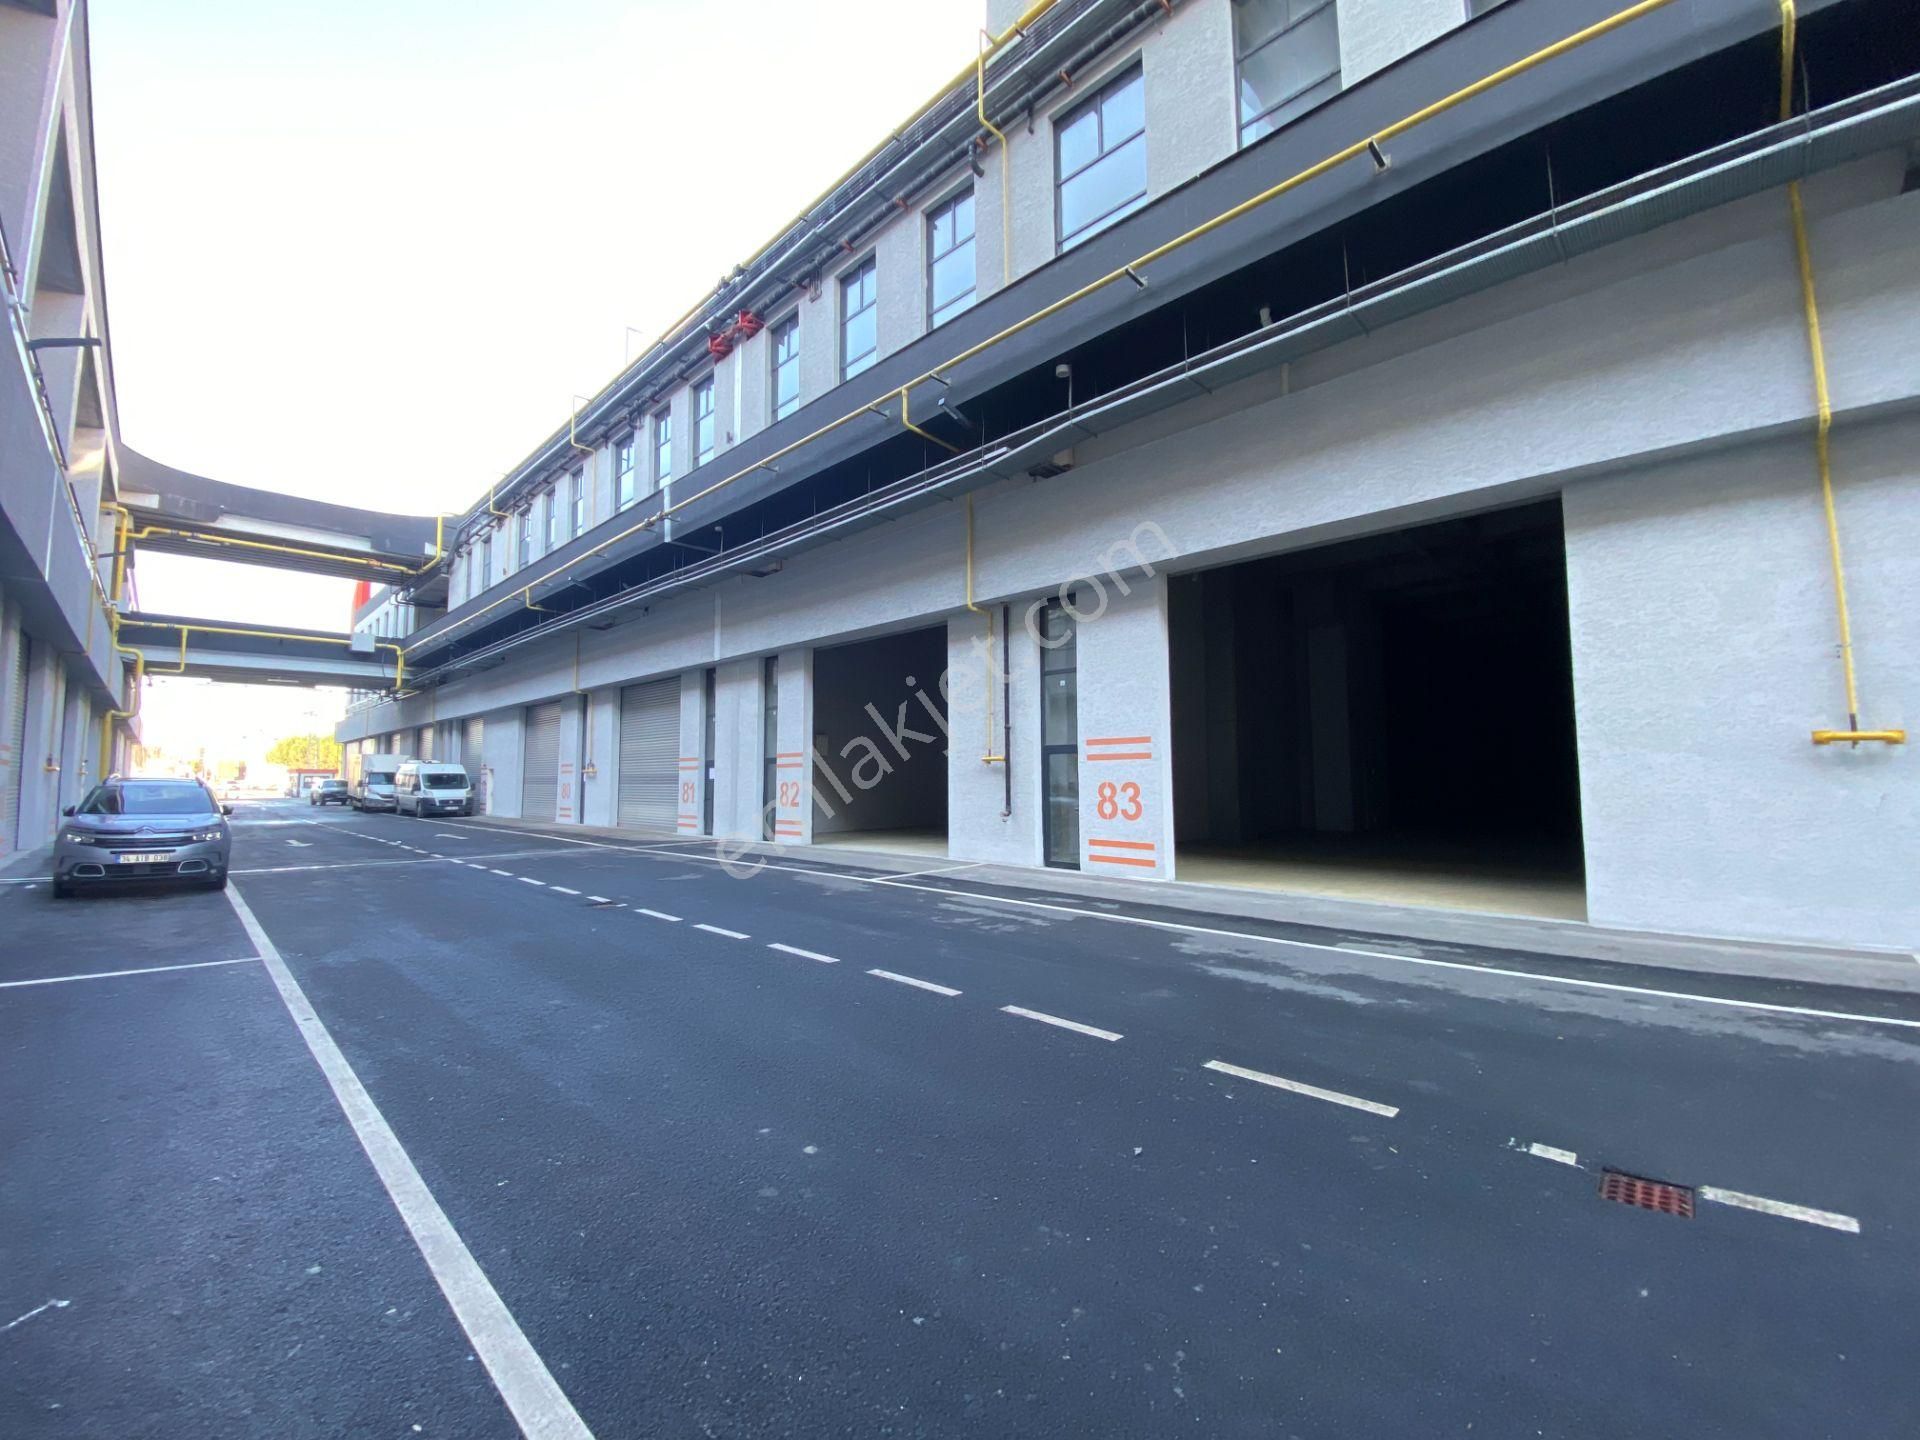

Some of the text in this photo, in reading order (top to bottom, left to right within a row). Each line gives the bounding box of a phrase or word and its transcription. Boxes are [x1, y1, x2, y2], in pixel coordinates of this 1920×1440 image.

[682, 783, 695, 804] 81
[779, 781, 801, 808] 82
[1097, 781, 1143, 821] 83
